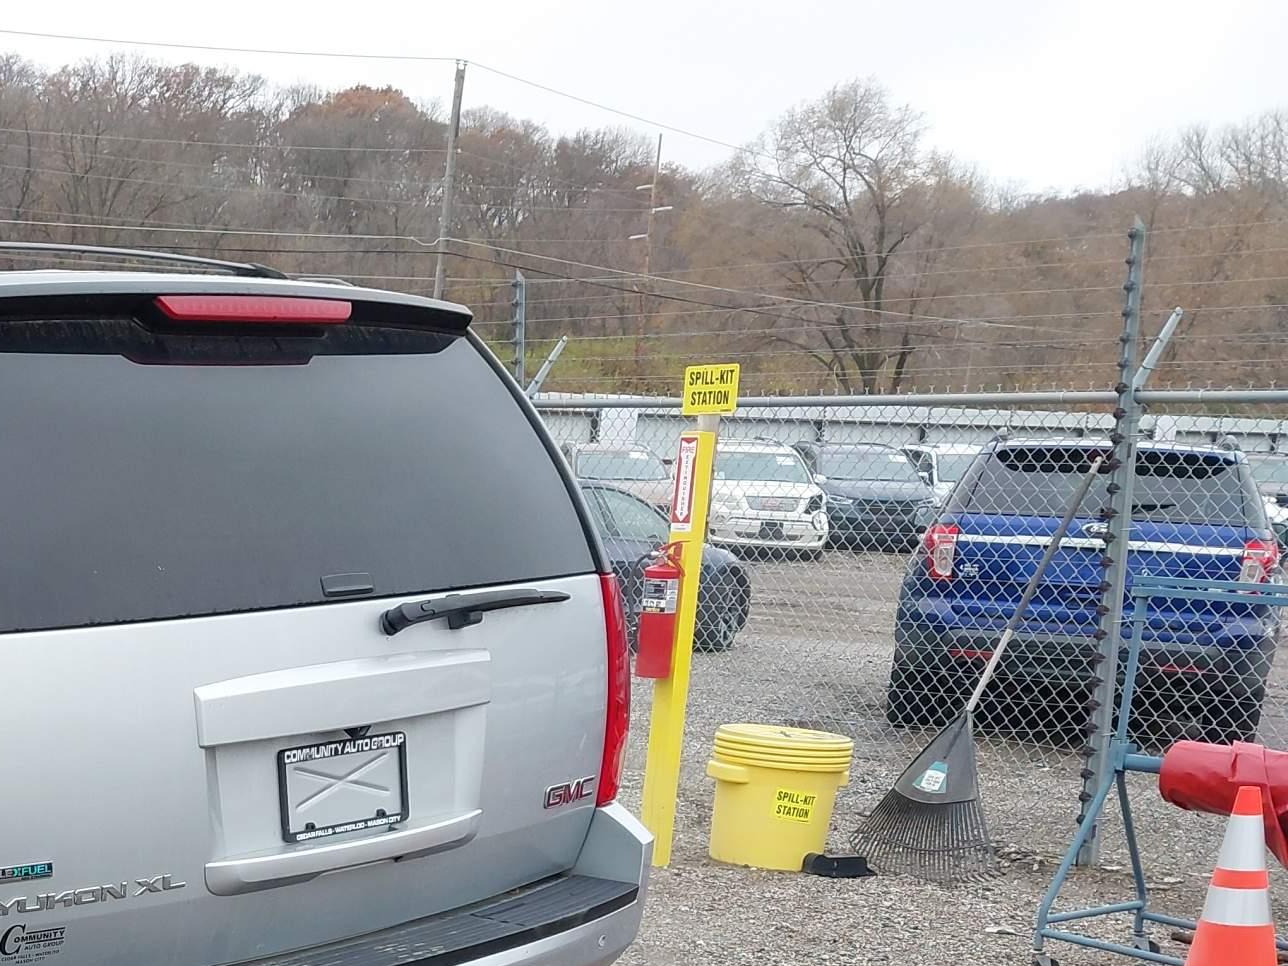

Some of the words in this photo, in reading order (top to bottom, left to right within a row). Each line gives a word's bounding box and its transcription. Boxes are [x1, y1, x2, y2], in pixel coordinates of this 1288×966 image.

[689, 369, 735, 386] SPILL-KIT
[690, 390, 730, 406] STATION
[284, 743, 344, 763] COMMUNITY
[344, 739, 370, 754] AUTO
[371, 733, 404, 750] GROUP
[544, 774, 596, 809] GMC
[776, 790, 816, 806] SPILL-KIT
[776, 804, 810, 818] STATION
[296, 831, 315, 841] CEDAR
[315, 828, 332, 837] FALLS
[335, 822, 365, 833] WATERLOO
[368, 818, 388, 827] MASON
[388, 816, 401, 824] CITY
[133, 873, 186, 897] XL
[0, 924, 65, 955] COMMUNITY
